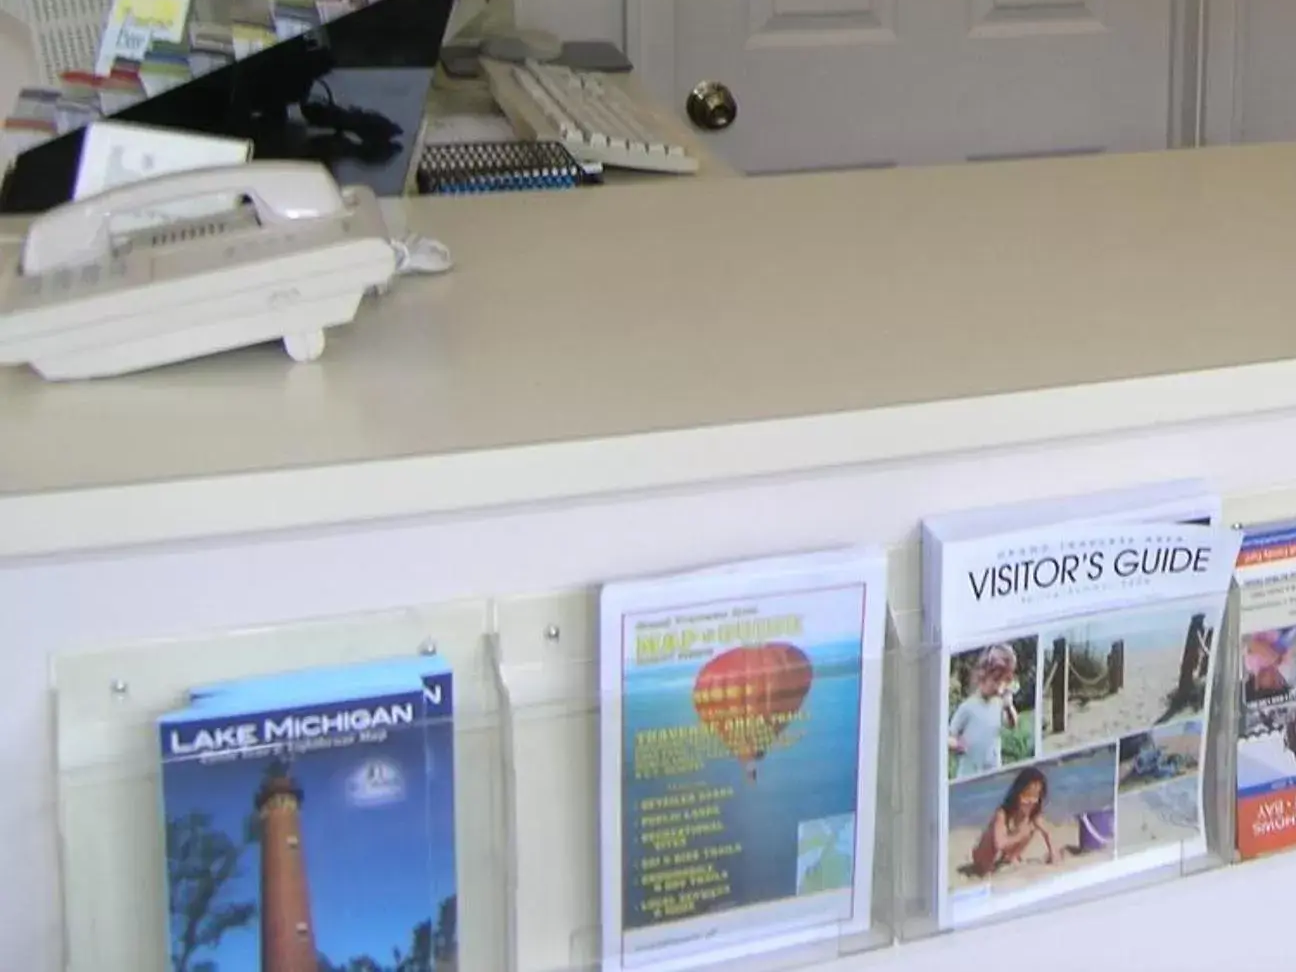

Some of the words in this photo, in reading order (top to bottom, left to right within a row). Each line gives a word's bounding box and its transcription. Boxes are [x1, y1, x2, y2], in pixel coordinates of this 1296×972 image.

[968, 550, 1105, 602] VISITOR'S
[1113, 546, 1213, 578] GUIDE
[170, 722, 259, 754] LAKE
[263, 702, 415, 743] MICHIGAN
